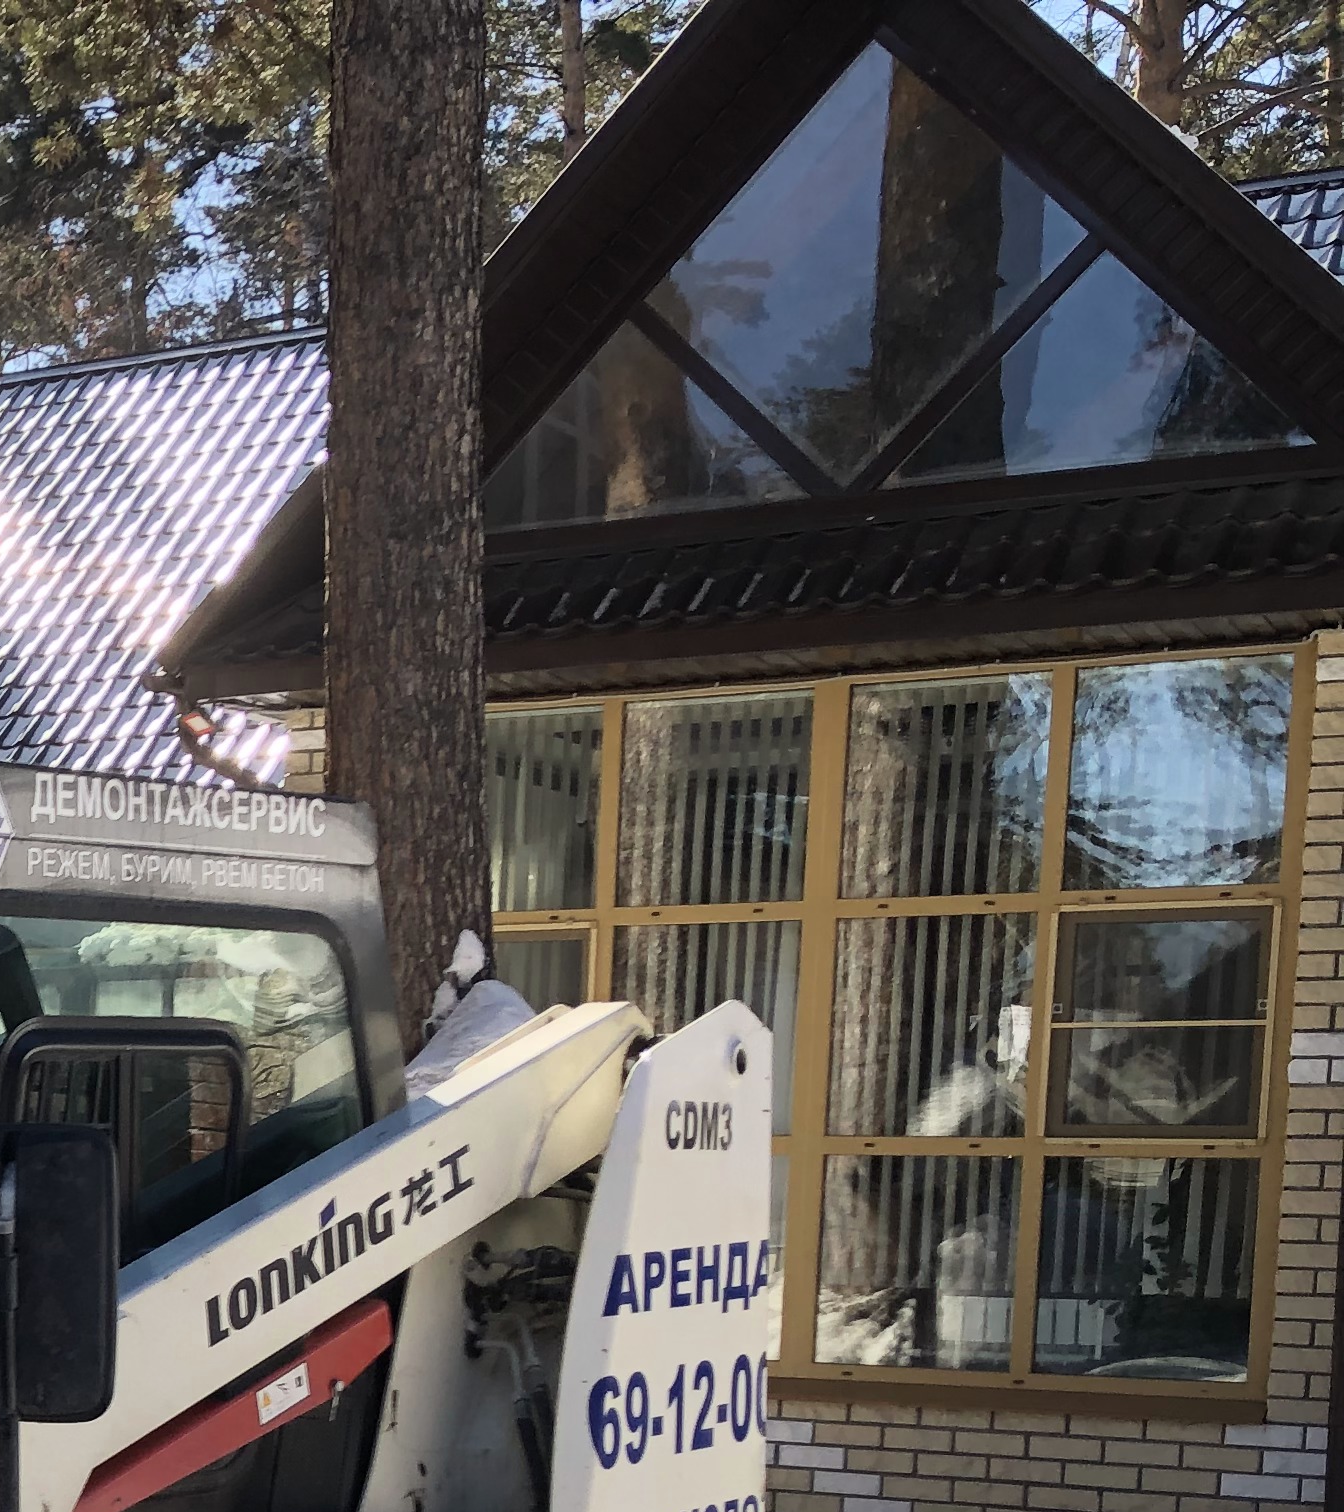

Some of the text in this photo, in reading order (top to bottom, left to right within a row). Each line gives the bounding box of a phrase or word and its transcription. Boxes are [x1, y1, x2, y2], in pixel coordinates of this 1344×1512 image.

[30, 772, 326, 838] ДЕМОНТАЖСЕРВИС
[121, 853, 197, 890] БУРИМ,
[261, 863, 324, 892] БЕТОН
